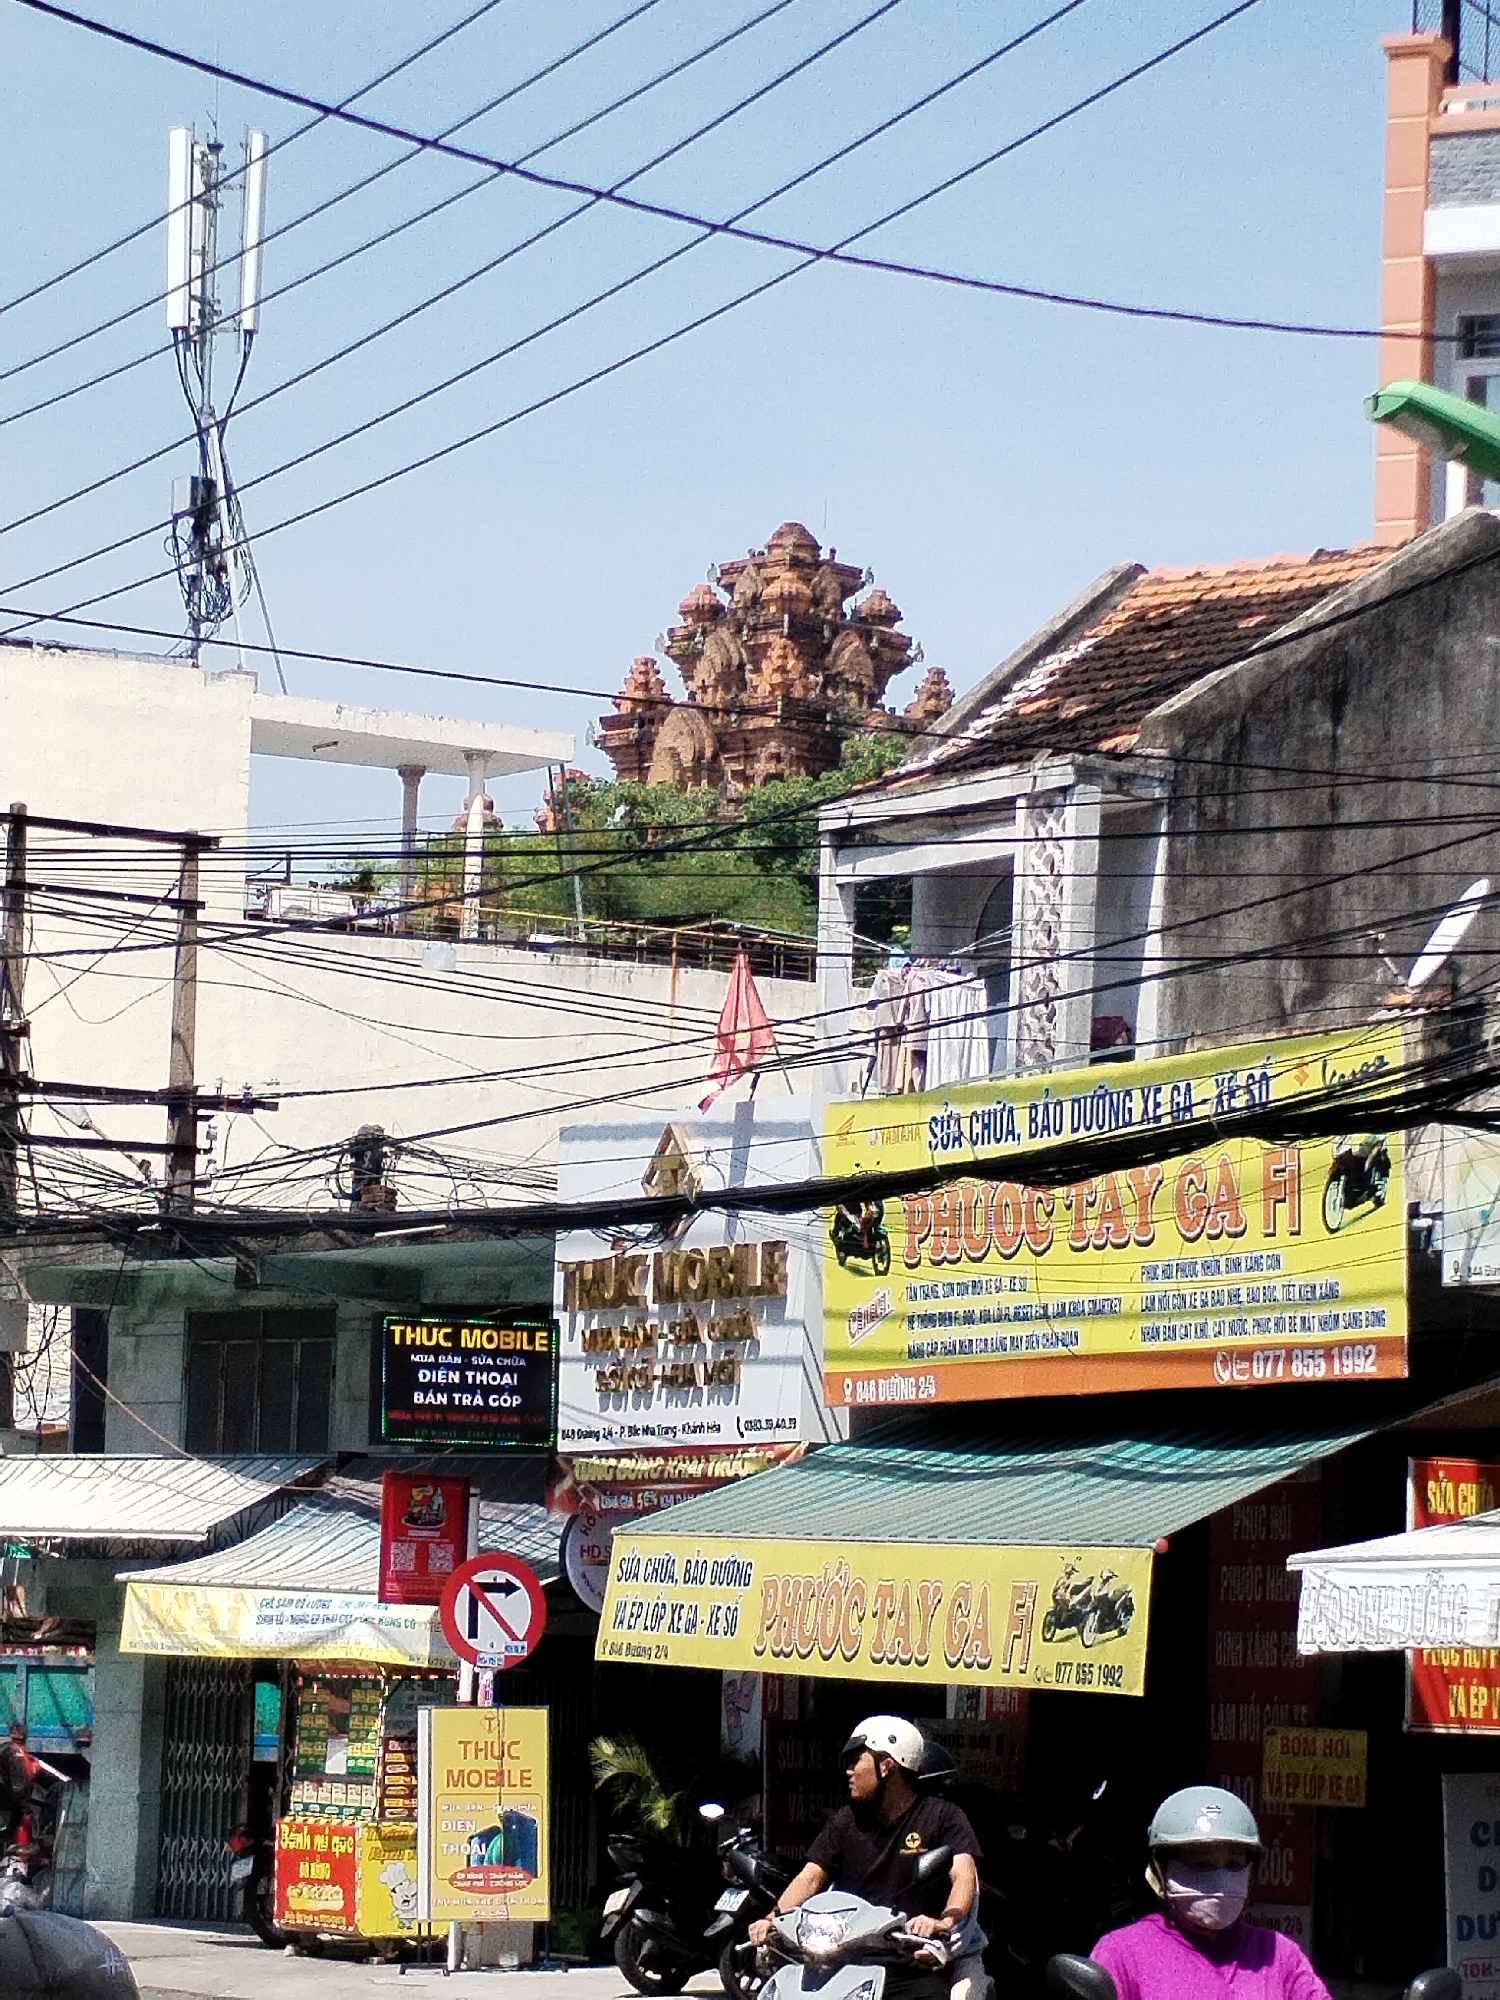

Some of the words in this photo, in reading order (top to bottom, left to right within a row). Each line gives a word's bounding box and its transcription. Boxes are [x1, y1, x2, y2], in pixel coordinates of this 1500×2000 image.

[928, 1100, 962, 1150] SỬA
[1029, 1088, 1064, 1139] BẢO
[1071, 1083, 1133, 1131] DƯỠNG
[1141, 1086, 1162, 1123] XE
[1171, 1081, 1194, 1121] GA
[1065, 1160, 1163, 1250] TAY
[1173, 1154, 1247, 1243] GA
[1262, 1144, 1301, 1236] FI
[461, 1328, 549, 1351] MOBILE
[410, 1353, 435, 1363] MUA
[471, 1353, 494, 1366] SỬA
[496, 1355, 527, 1367] CHỮA
[1252, 1349, 1287, 1380] 077
[1291, 1346, 1327, 1378] 855
[1331, 1343, 1378, 1375] 1992
[418, 1366, 460, 1386] ĐIỆN
[465, 1370, 518, 1389] THOẠI
[413, 1388, 448, 1406] BÁN
[452, 1389, 484, 1407] TRẢ
[488, 1391, 522, 1408] GÓP
[1428, 1470, 1455, 1515] SỬA
[617, 1547, 641, 1584] SỬA
[643, 1550, 678, 1588] CHỮA,
[683, 1549, 708, 1586] BẢO
[710, 1551, 754, 1587] DƯỠNG
[611, 1593, 627, 1631] VÁ
[627, 1591, 645, 1631] ÉP
[667, 1602, 684, 1635] XE
[684, 1603, 699, 1636] GA
[706, 1603, 722, 1637] XE
[722, 1594, 744, 1638] SỐ
[754, 1556, 868, 1662] PHƯỚC
[870, 1579, 943, 1667] TAY
[944, 1580, 993, 1670] GA
[1001, 1580, 1039, 1674] FI
[654, 1645, 670, 1660] 2/4
[1055, 1661, 1074, 1684] 077
[1075, 1662, 1094, 1685] 855
[1097, 1663, 1123, 1688] 1992
[446, 1768, 532, 1788] MOBILE
[280, 1824, 311, 1850] Bánh
